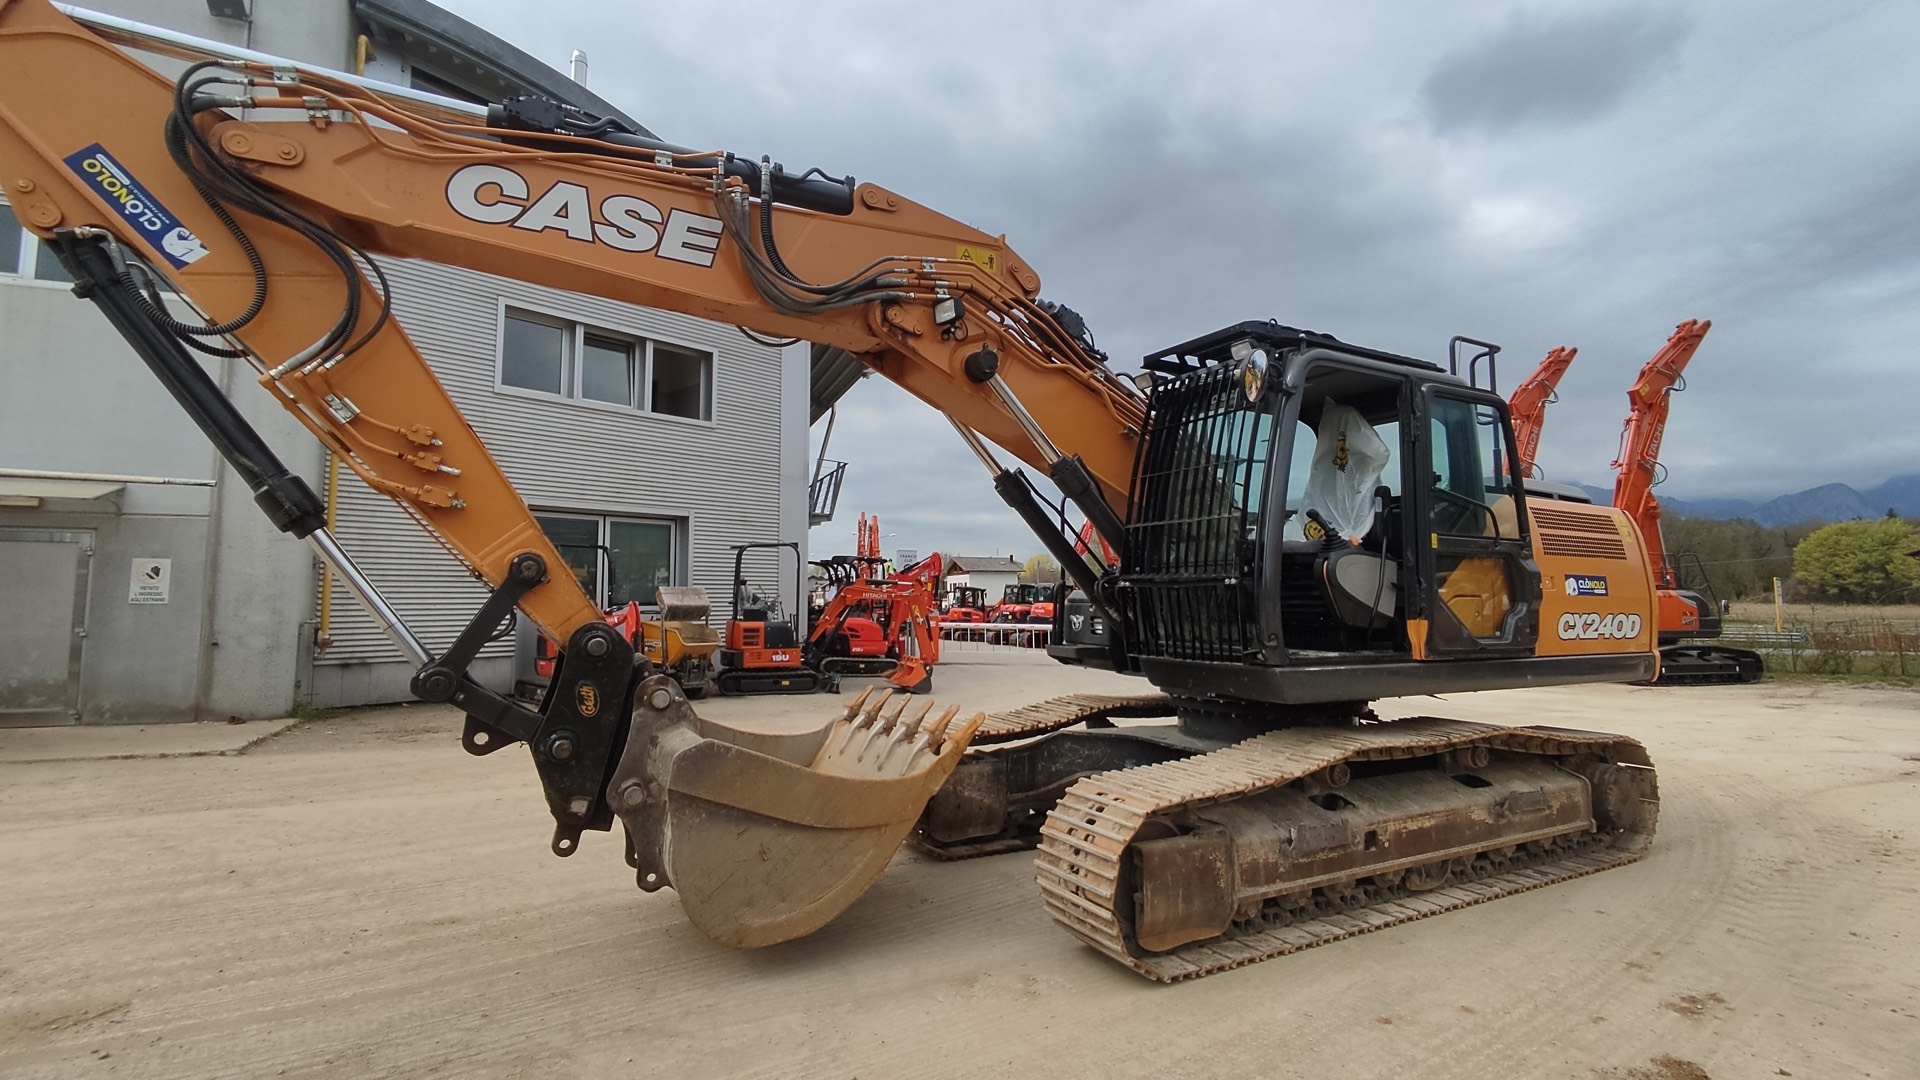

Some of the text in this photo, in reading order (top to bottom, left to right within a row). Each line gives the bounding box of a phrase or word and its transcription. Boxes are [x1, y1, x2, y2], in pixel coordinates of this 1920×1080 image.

[445, 163, 725, 268] CASE
[1558, 612, 1642, 640] CX240D
[772, 654, 790, 662] 19U
